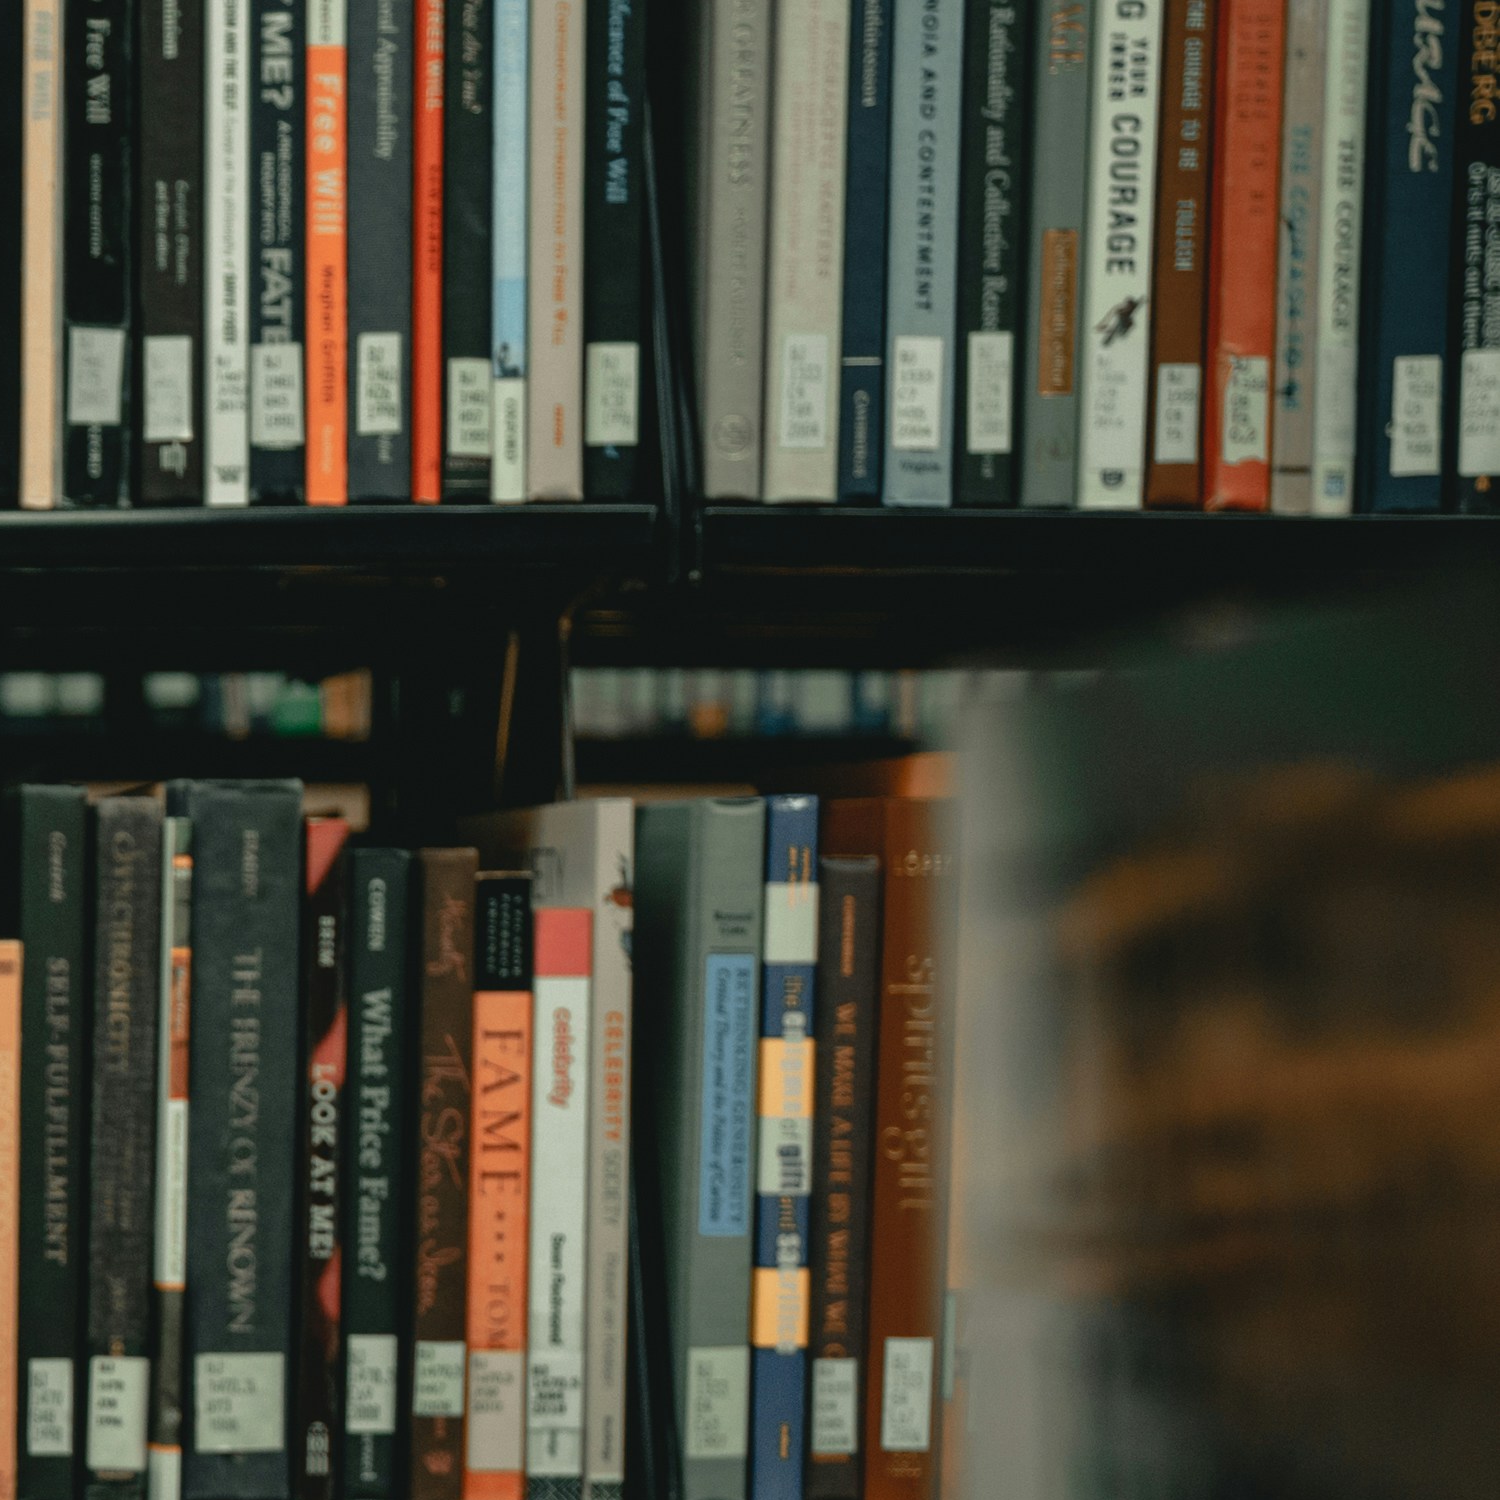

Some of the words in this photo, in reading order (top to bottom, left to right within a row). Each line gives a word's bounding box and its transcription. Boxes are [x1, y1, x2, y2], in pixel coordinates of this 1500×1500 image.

[85, 17, 112, 70] Free
[259, 11, 293, 111] ME?
[1107, 31, 1129, 102] INNER
[1127, 36, 1149, 99] YOUR
[85, 72, 113, 126] Will
[311, 73, 344, 154] Free
[917, 67, 940, 121] AND
[605, 156, 630, 204] Will
[987, 126, 1012, 164] and
[311, 168, 344, 236] Will
[914, 128, 939, 314] CONTENTMENT
[1105, 112, 1146, 276] COURAGE
[259, 248, 294, 345] FATE
[1332, 199, 1357, 333] COURAGE
[368, 877, 387, 951] COWEN
[230, 947, 263, 1010] THE
[361, 986, 393, 1077] What
[546, 1006, 575, 1109] celebrity
[43, 956, 71, 1267] SELF-FULFILLMENT
[310, 1062, 338, 1148] LOOK
[477, 1027, 526, 1198] FAME
[603, 1010, 625, 1143] CELEBRITY
[360, 1086, 392, 1168] Price
[773, 1143, 805, 1191] gift
[309, 1153, 337, 1198] AT
[357, 1175, 389, 1282] Fame?
